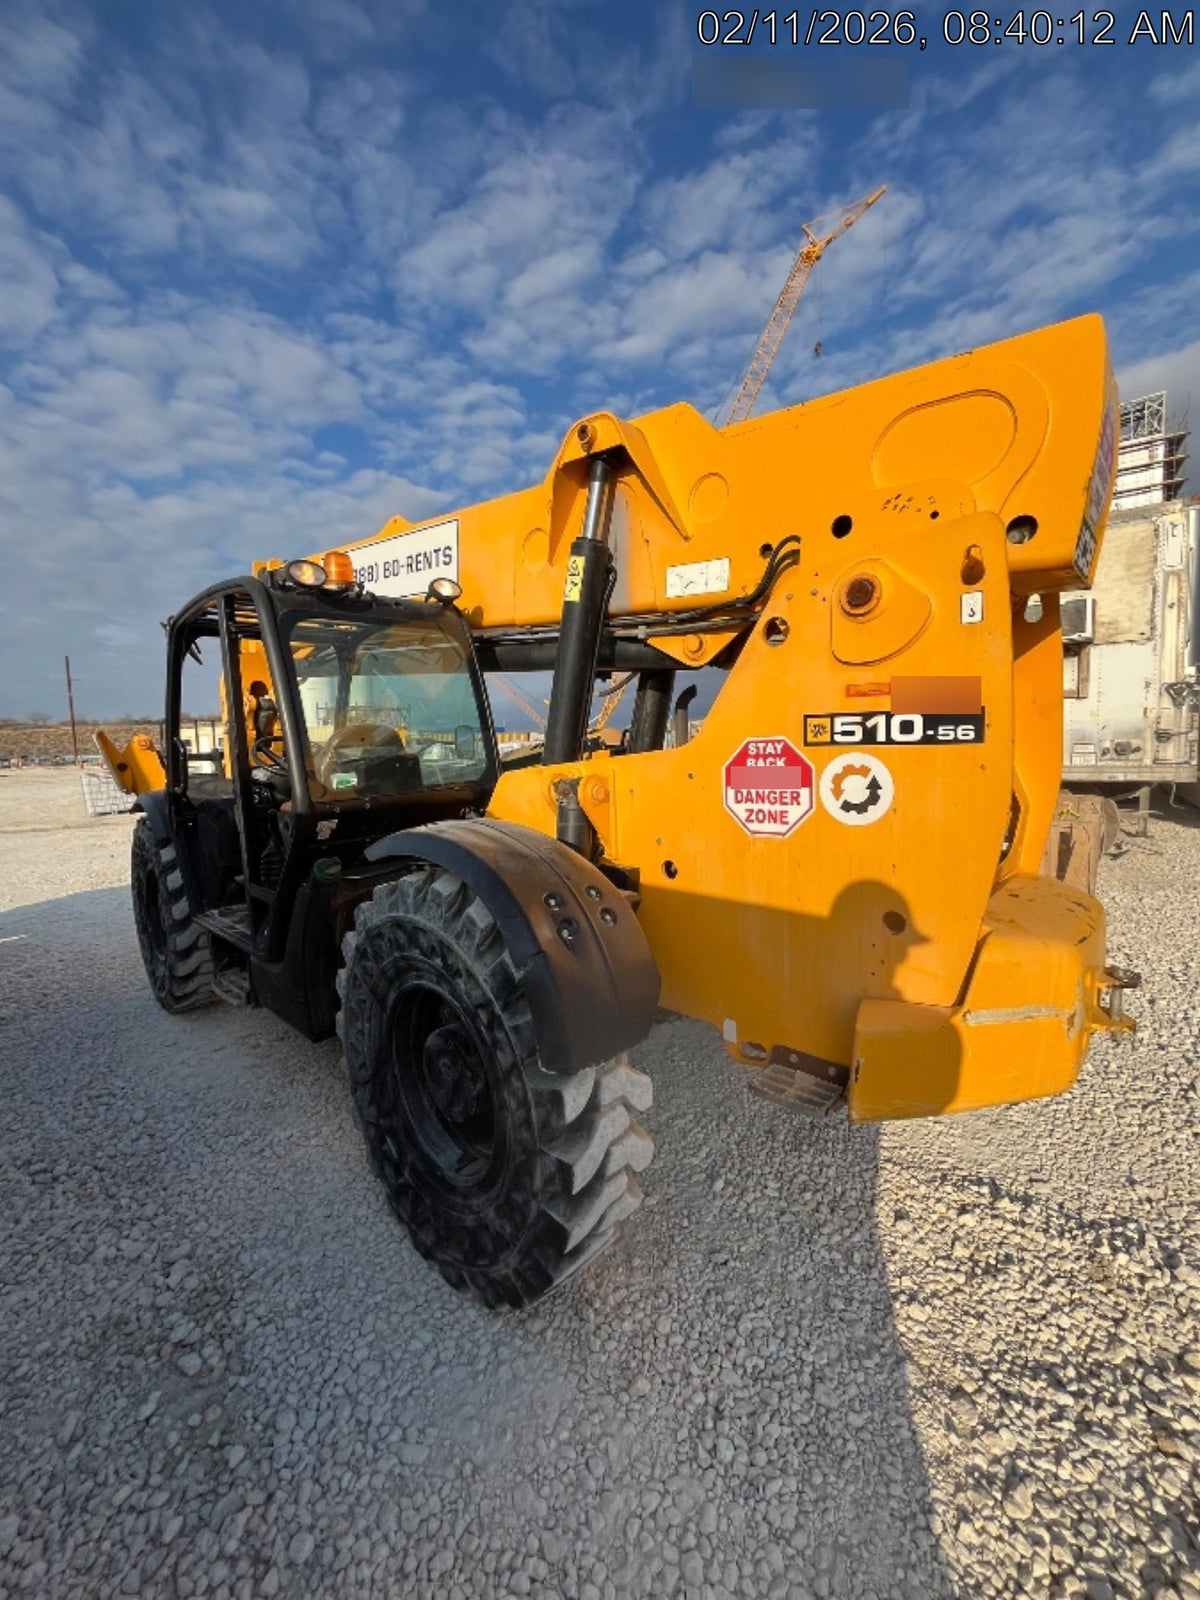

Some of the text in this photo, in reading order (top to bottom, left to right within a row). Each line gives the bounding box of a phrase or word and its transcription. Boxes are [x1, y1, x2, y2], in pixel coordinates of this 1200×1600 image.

[833, 713, 976, 743] 510-56
[747, 742, 785, 755] STAY
[734, 789, 801, 806] DANGER
[744, 808, 790, 826] ZONE
